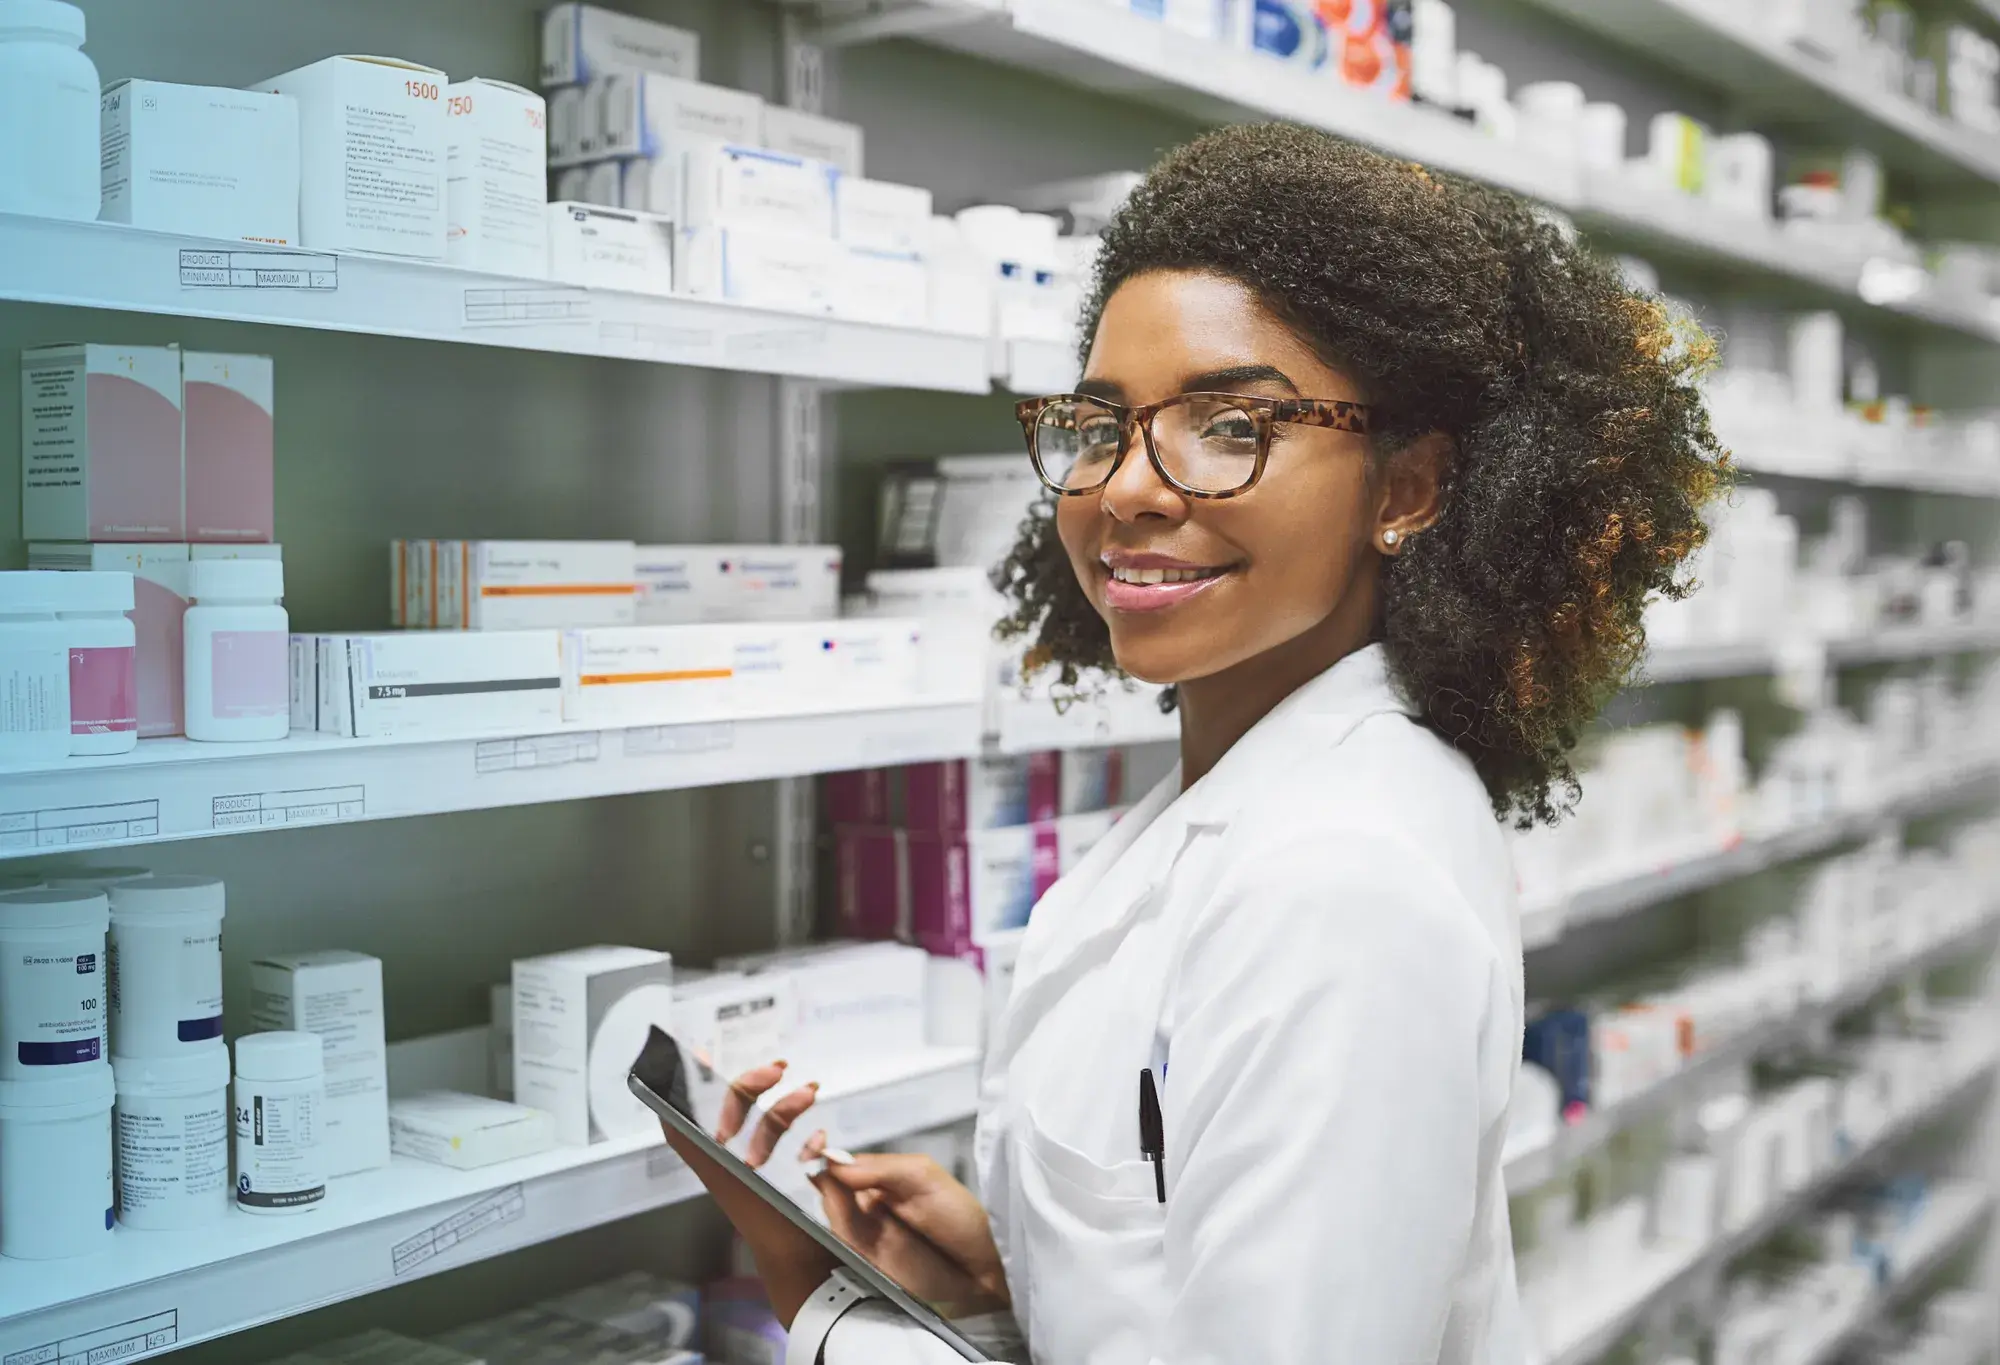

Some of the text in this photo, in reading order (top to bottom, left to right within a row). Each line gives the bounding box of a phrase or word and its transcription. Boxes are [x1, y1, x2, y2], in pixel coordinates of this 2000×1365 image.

[405, 80, 439, 101] 1500
[447, 95, 473, 117] 750
[182, 254, 223, 265] PRODUCT:
[182, 272, 225, 283] MINIMUM
[258, 274, 300, 284] MAXIMUM
[81, 998, 97, 1011] 100
[90, 1342, 136, 1364] MAXIMUM
